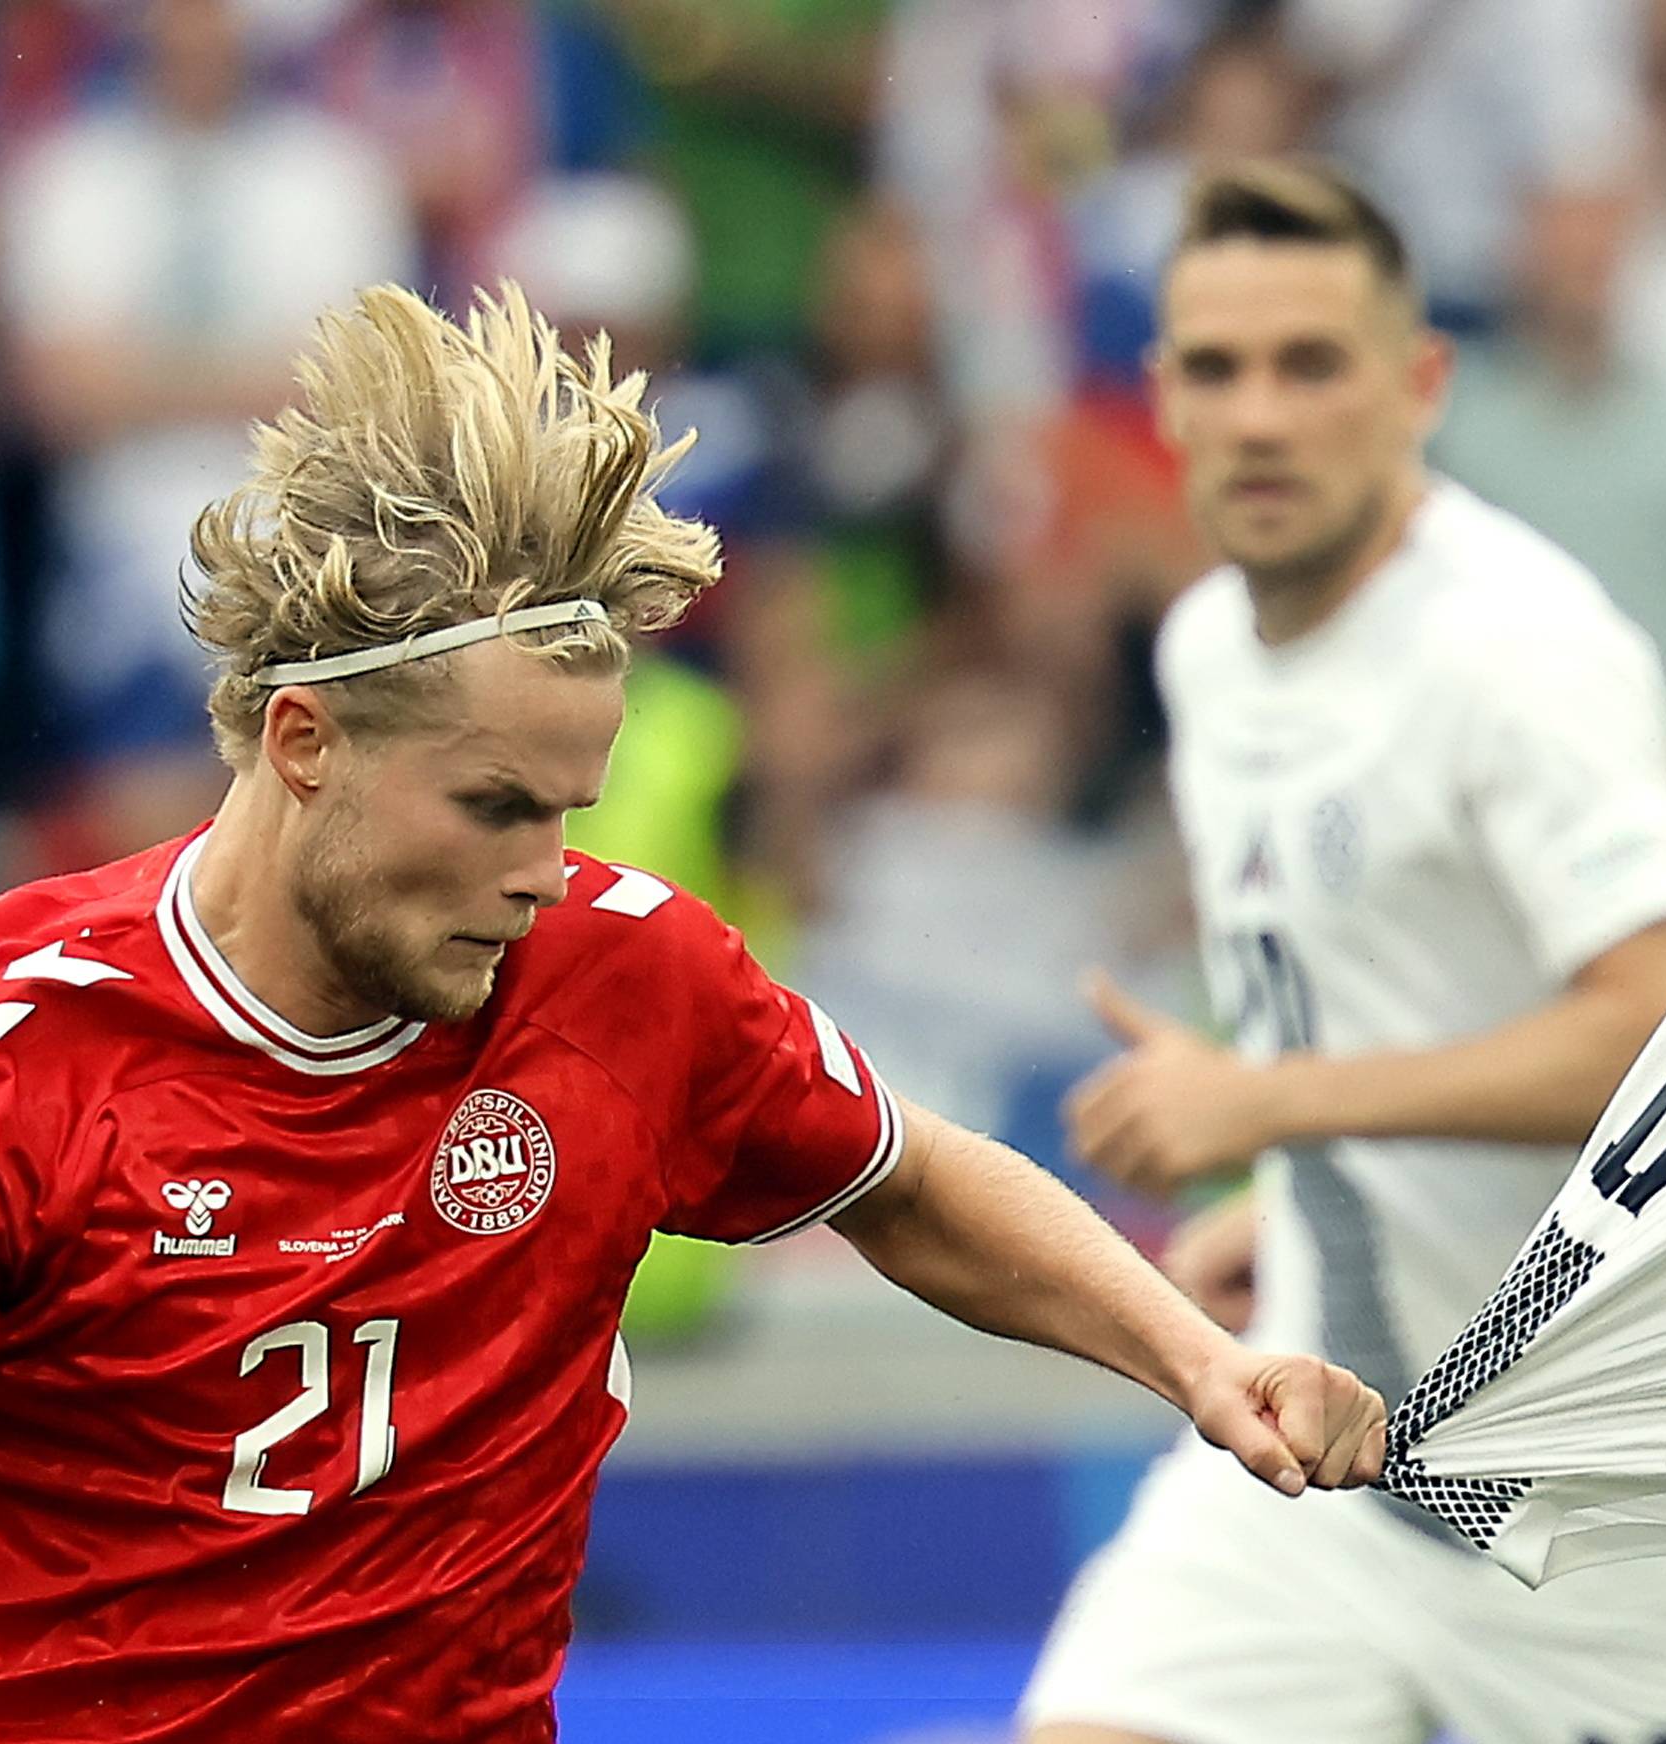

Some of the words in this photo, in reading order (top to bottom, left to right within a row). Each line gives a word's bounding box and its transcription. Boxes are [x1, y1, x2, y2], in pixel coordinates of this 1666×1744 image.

[449, 1134, 528, 1184] DBU
[525, 1126, 551, 1204] UNION
[469, 1204, 525, 1230] 1889
[153, 1230, 236, 1256] hummel
[278, 1240, 339, 1253] SLOVENIA
[222, 1319, 399, 1515] 21
